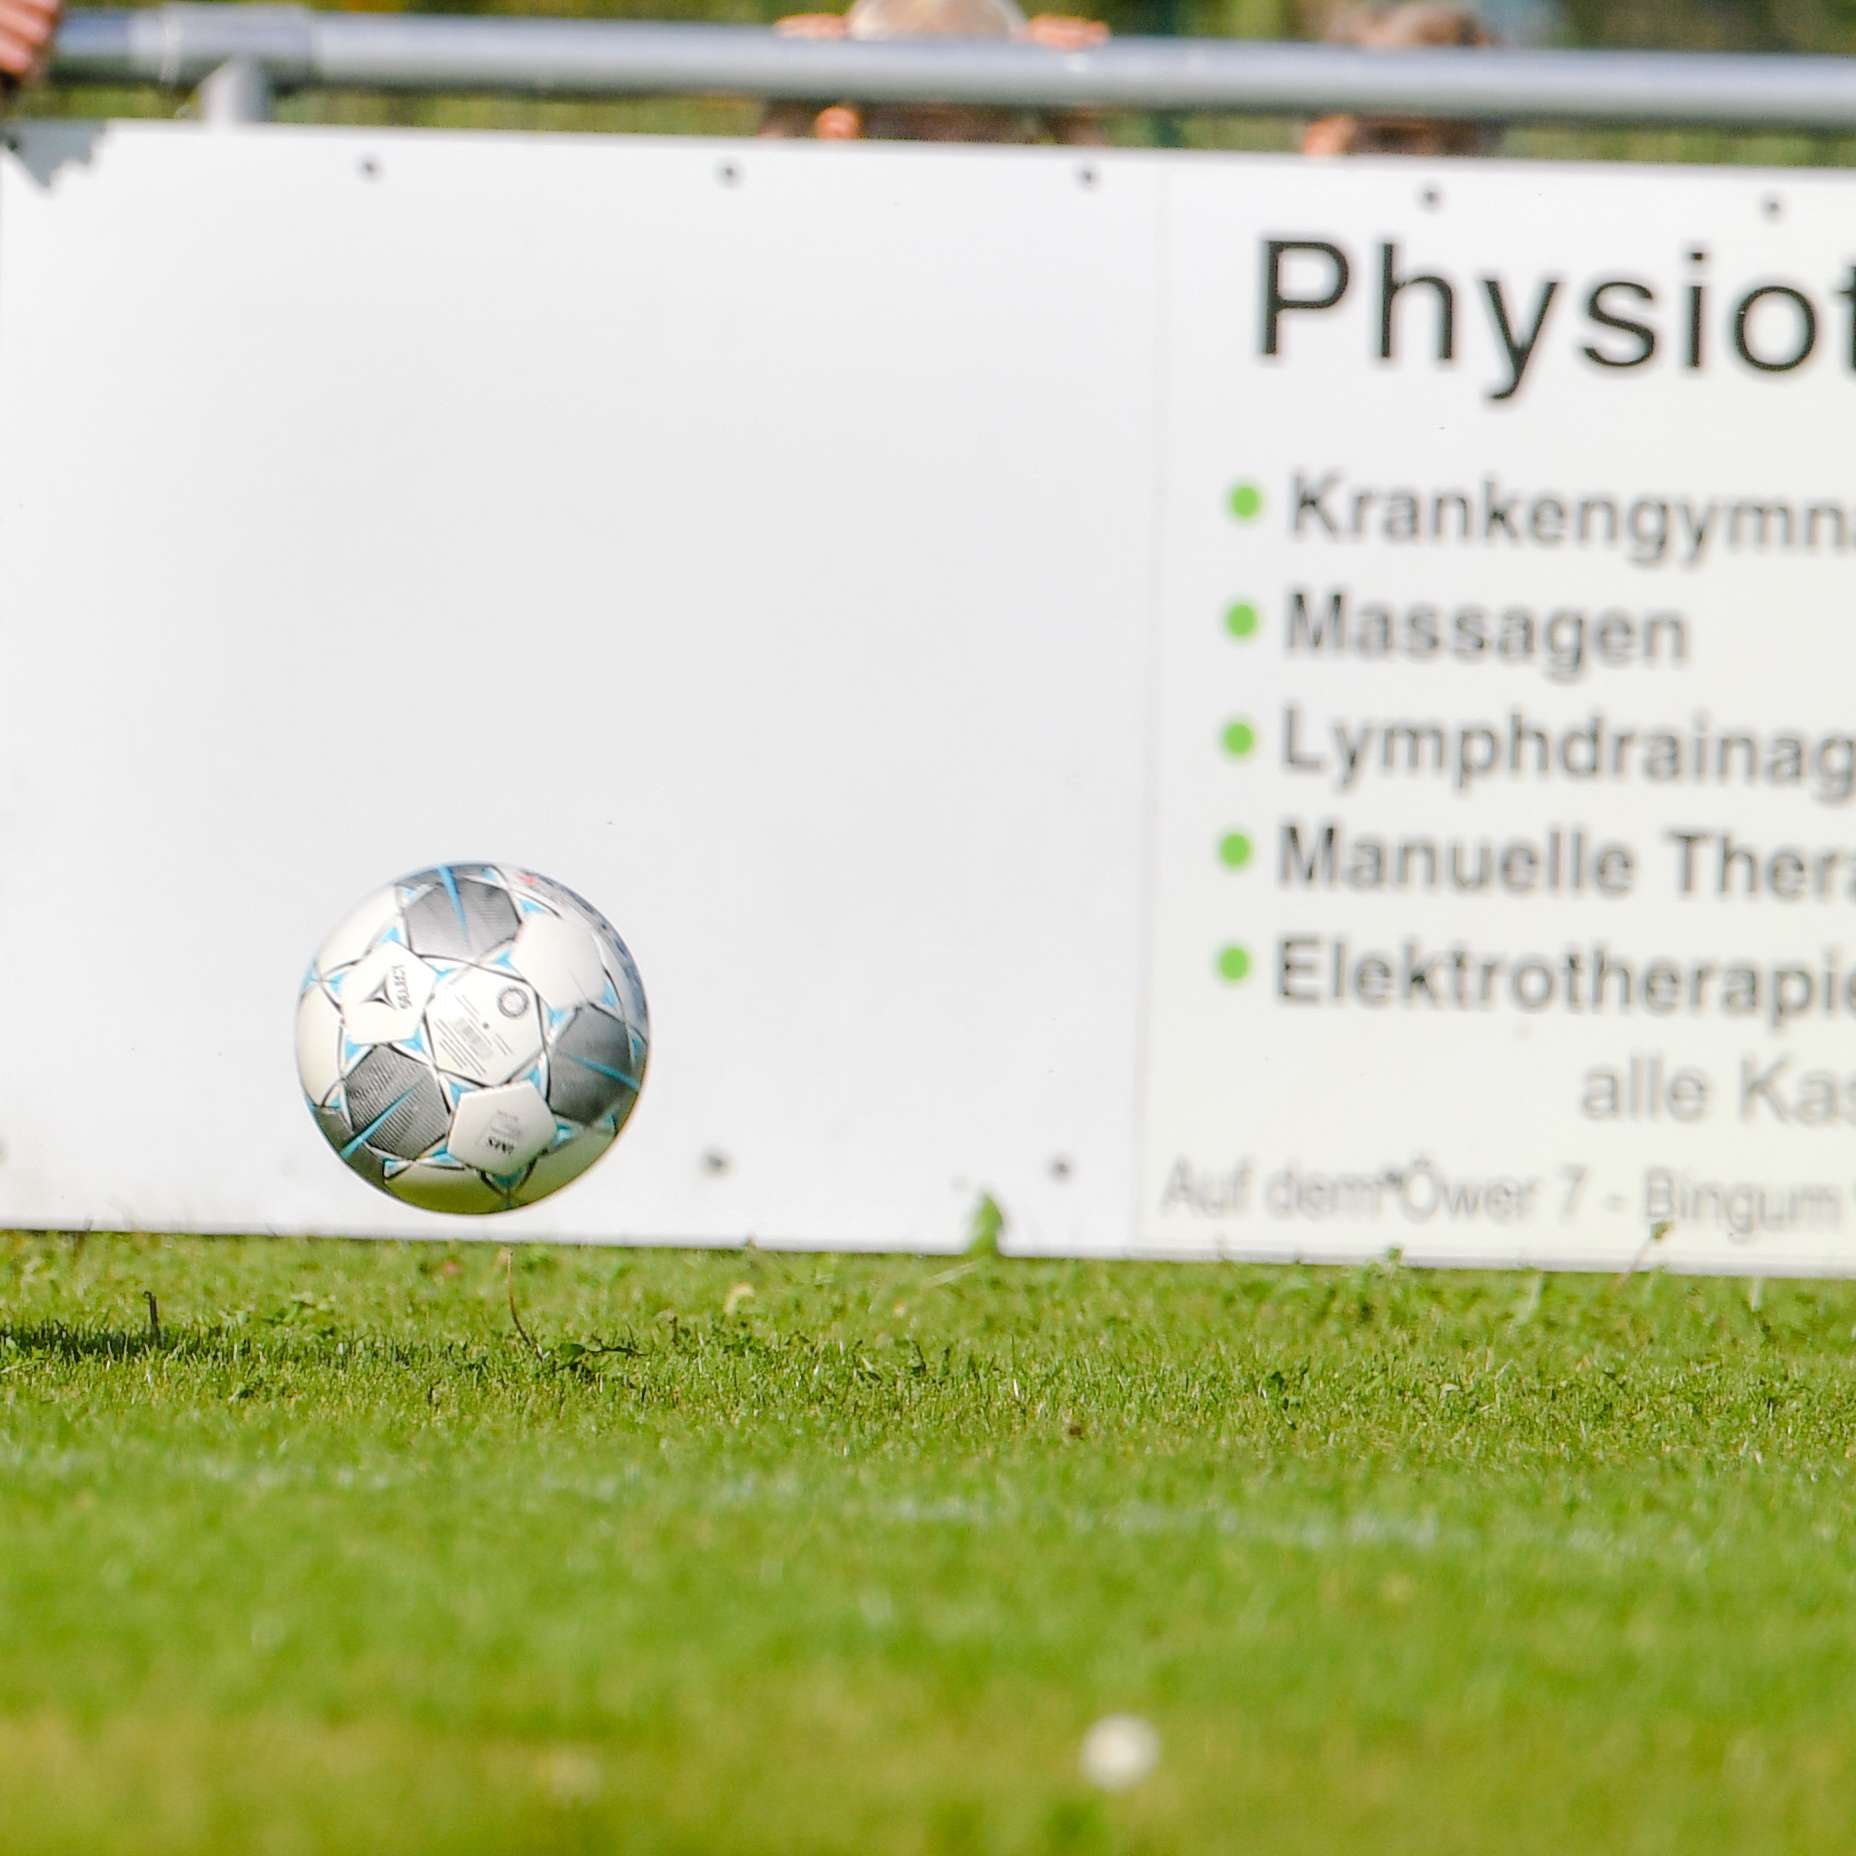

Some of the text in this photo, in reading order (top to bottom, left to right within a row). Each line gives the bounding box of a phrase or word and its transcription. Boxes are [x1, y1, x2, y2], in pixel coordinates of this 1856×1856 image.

[1290, 470, 1856, 569] Krankengymn
[1285, 587, 1690, 684] Massagen
[1279, 822, 1636, 896] Manuelle
[1582, 1056, 1856, 1126] alle Ka
[1162, 1158, 1254, 1217] Auf
[1645, 1166, 1842, 1237] Bingum
